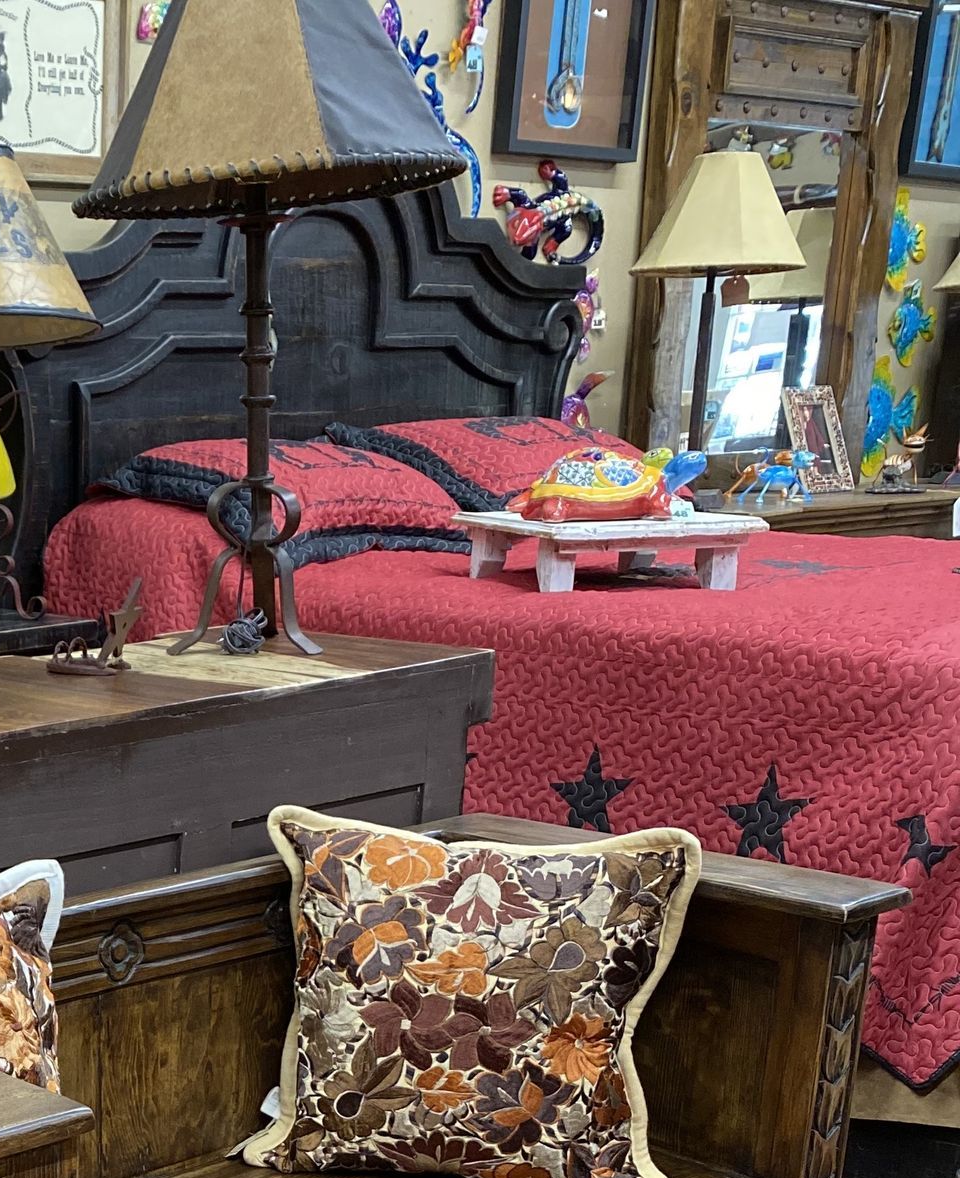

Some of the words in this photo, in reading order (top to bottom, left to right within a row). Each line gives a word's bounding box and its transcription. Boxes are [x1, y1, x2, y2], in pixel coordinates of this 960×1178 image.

[34, 50, 45, 62] Love
[57, 55, 62, 64] or
[38, 66, 46, 78] I'll
[68, 69, 77, 80] half
[64, 86, 72, 97] you
